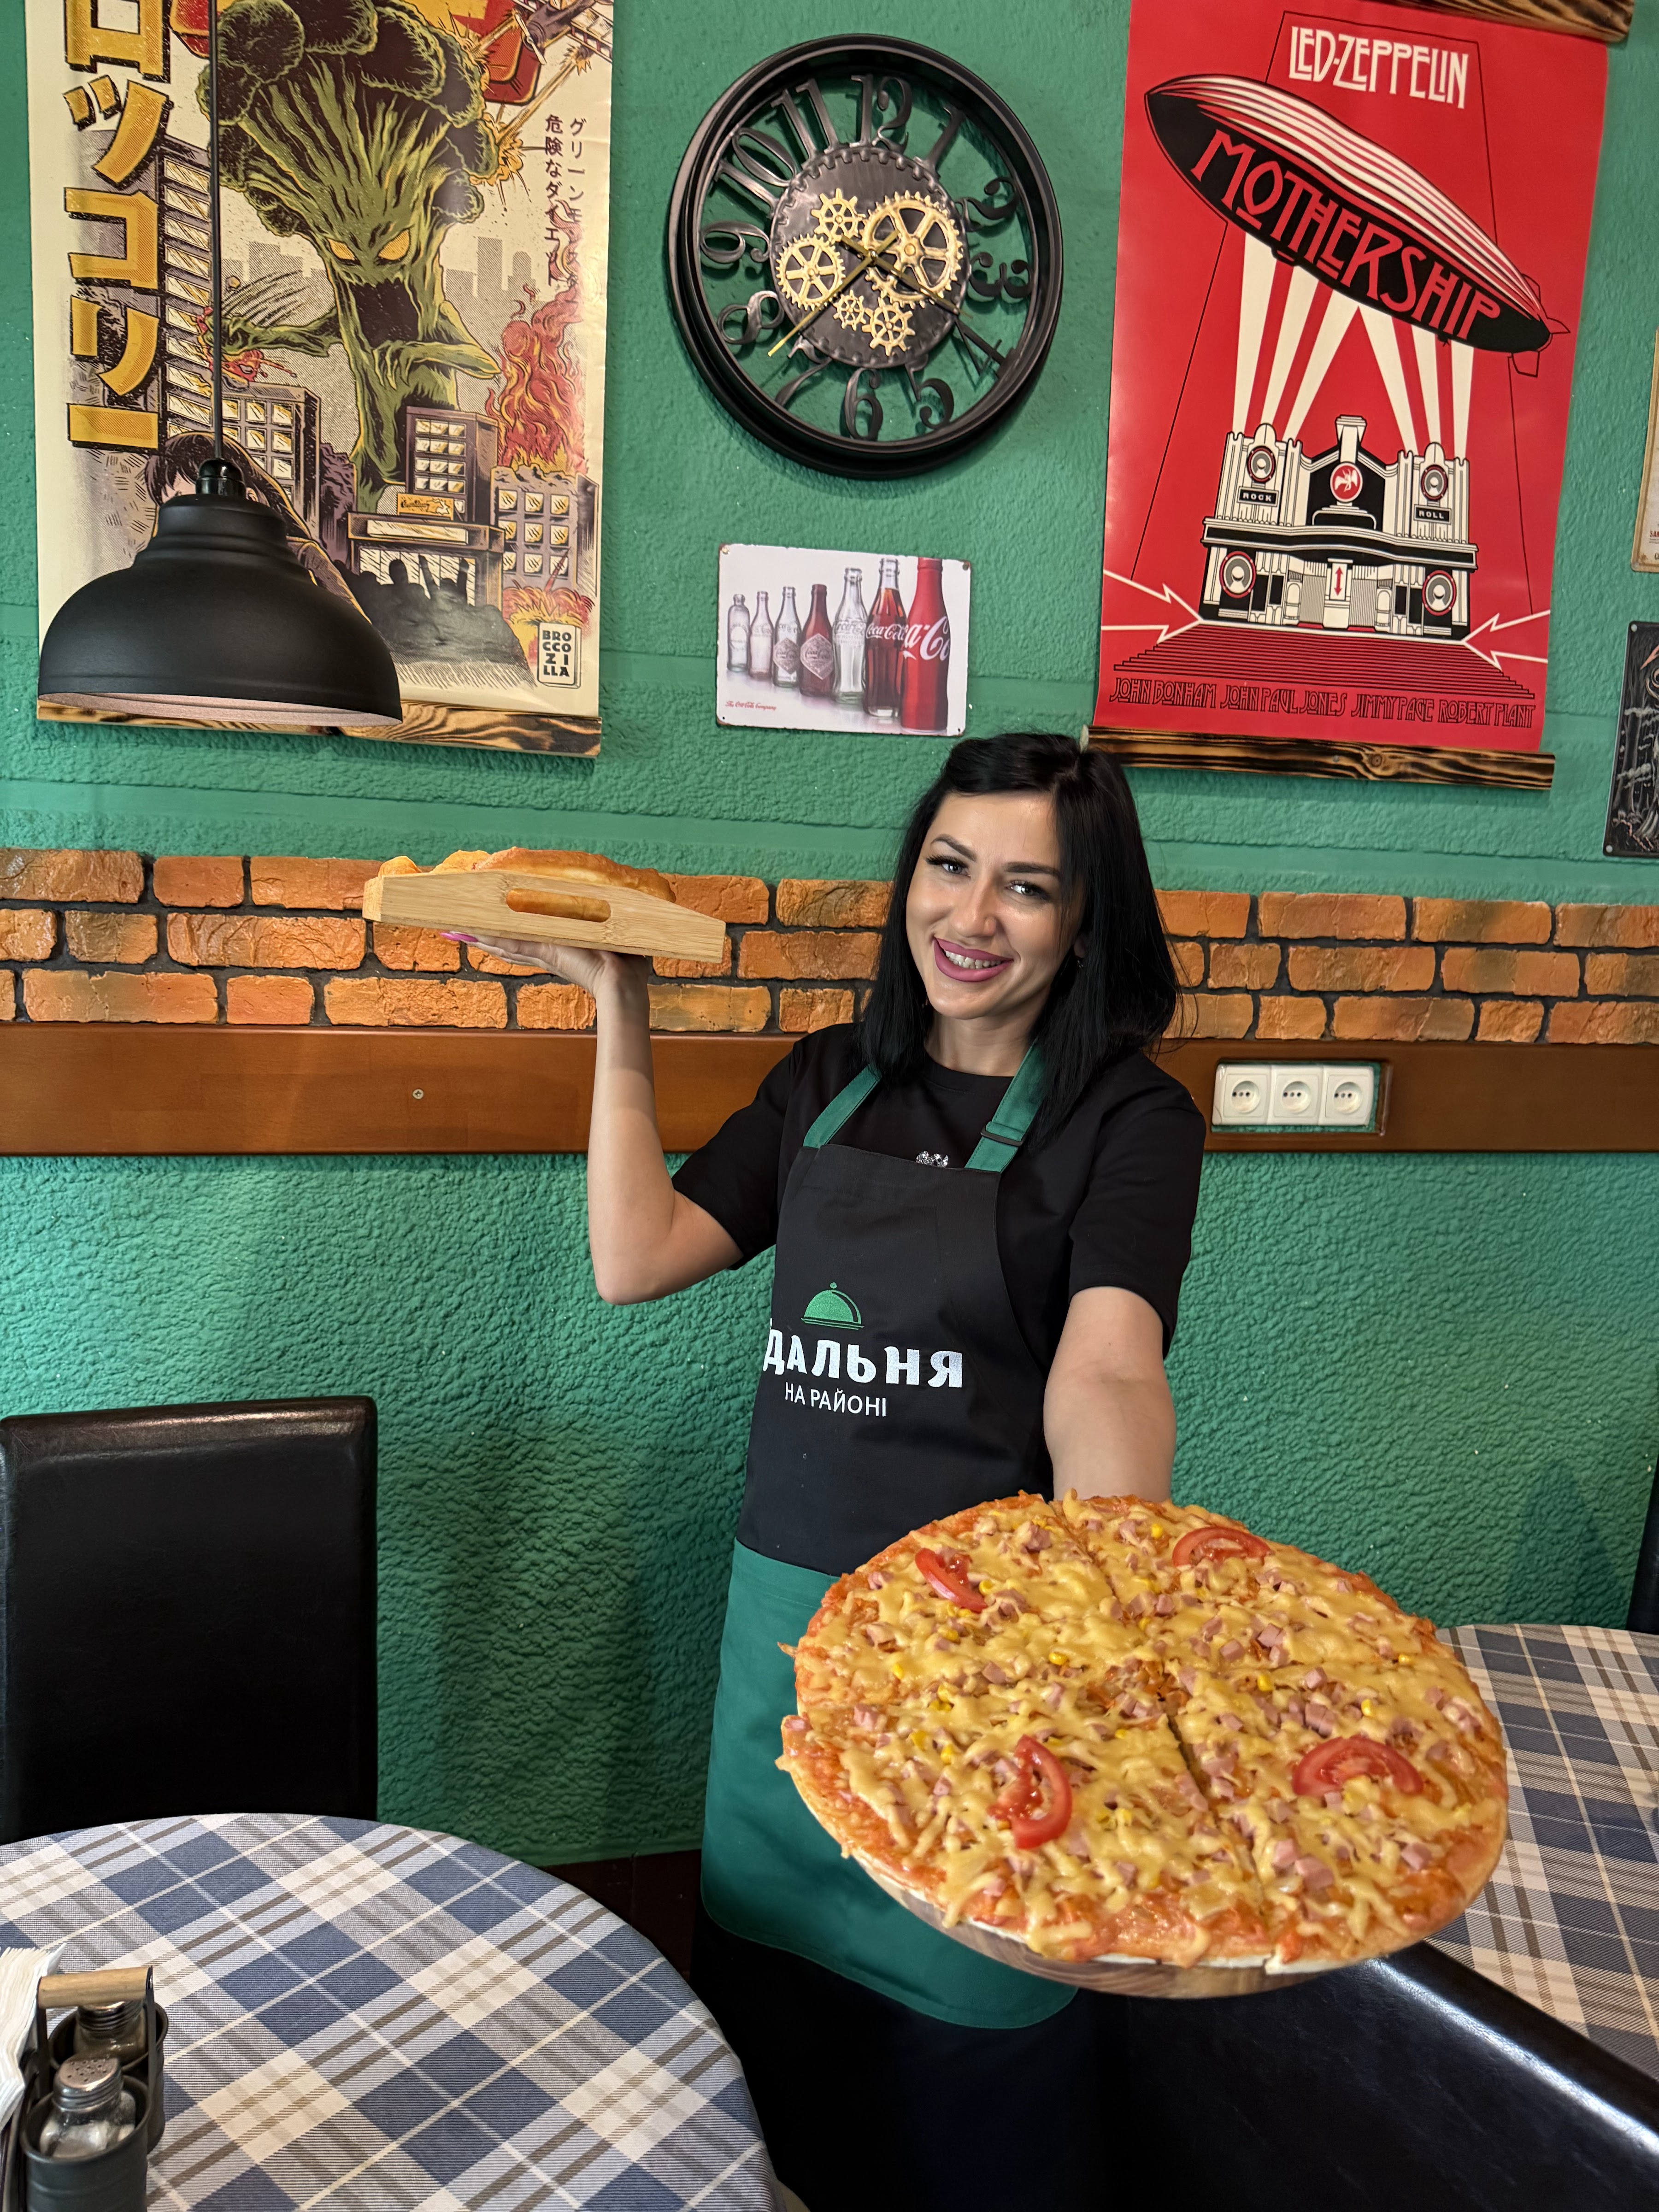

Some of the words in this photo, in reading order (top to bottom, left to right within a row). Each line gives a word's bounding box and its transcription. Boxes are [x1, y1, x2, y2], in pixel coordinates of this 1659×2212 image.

[1289, 26, 1469, 109] LED-ZEPPELIN
[771, 78, 838, 170] 11
[851, 74, 912, 154] 12
[914, 106, 964, 177] 1
[713, 127, 796, 219] 10
[955, 176, 1019, 232] 2
[700, 220, 770, 263] 9
[1190, 129, 1500, 340] MOTHERSHIP
[969, 252, 1033, 298] 3
[718, 290, 785, 344] 8
[775, 335, 833, 406] 7
[904, 354, 954, 430] 5
[845, 368, 883, 441] 6
[1242, 492, 1273, 503] ROCK
[1418, 509, 1445, 520] ROLL
[542, 630, 571, 641] BRO
[542, 641, 571, 653] CCO
[543, 665, 570, 677] LLA
[1110, 677, 1152, 704] JOHN
[1152, 680, 1217, 708] BONHAM
[1220, 685, 1258, 712] JOHN
[1260, 688, 1298, 714] PAUL
[1299, 690, 1347, 717] JONES
[1351, 694, 1399, 720] JIMMY
[1397, 696, 1434, 723] PAGE
[1437, 699, 1495, 725] ROBERT
[1494, 702, 1536, 728] PLANT
[763, 1319, 963, 1388] ДАЛЬНЯ
[785, 1382, 806, 1405] НА
[810, 1388, 886, 1417] РАЙОНІ
